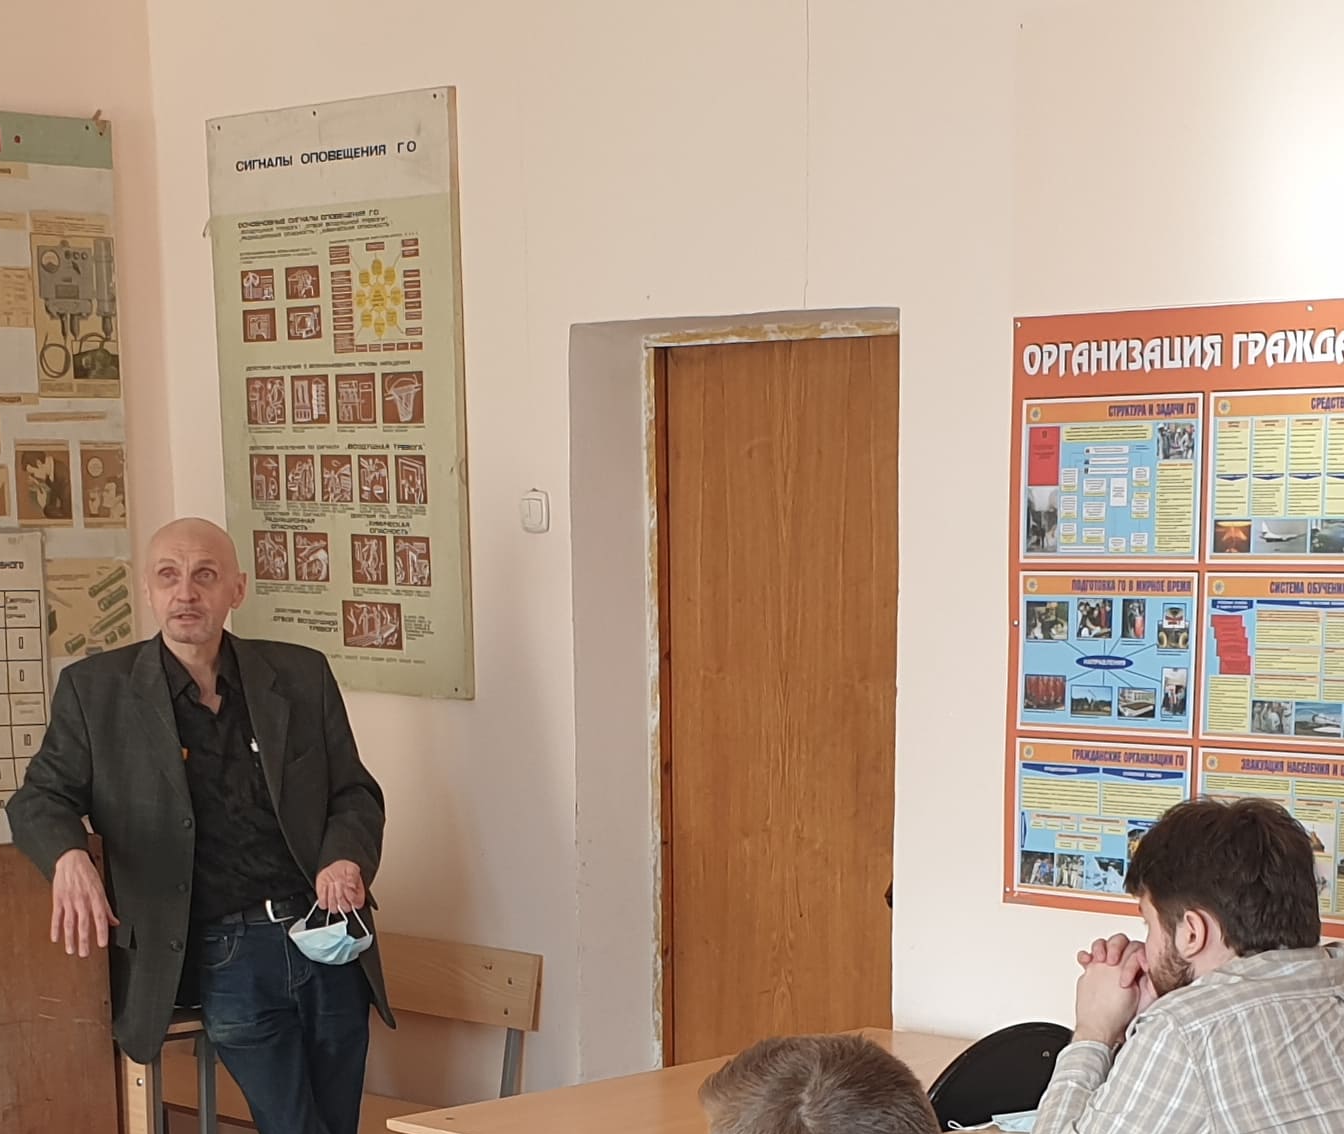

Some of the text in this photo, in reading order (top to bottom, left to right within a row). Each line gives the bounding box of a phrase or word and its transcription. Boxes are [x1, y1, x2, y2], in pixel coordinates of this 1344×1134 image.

[236, 140, 417, 172] СИГНАЛЫ ОПОВЕЩЕНИЯ ГО
[1023, 332, 1223, 378] ОРГАНИЗАЦИЯ
[1108, 402, 1196, 417] СТРУКТУРА И ЗАДАЧИ ГО
[1071, 579, 1192, 593] ПОДГОТОВКА ГО В МИРНОЕ ВРЕМЯ
[1269, 581, 1304, 594] СИСТЕМА
[18, 636, 24, 649] 0
[19, 669, 25, 682] 0
[24, 734, 31, 746] 10
[1072, 749, 1184, 766] ГРАЖДАНСКИЕ ОРГАНИЗАЦИИ ГО
[1241, 758, 1284, 772] ЭВАКУАЦИЯ
[1287, 761, 1330, 776] НАСЕЛЕНИЯ
[1333, 763, 1338, 775] И
